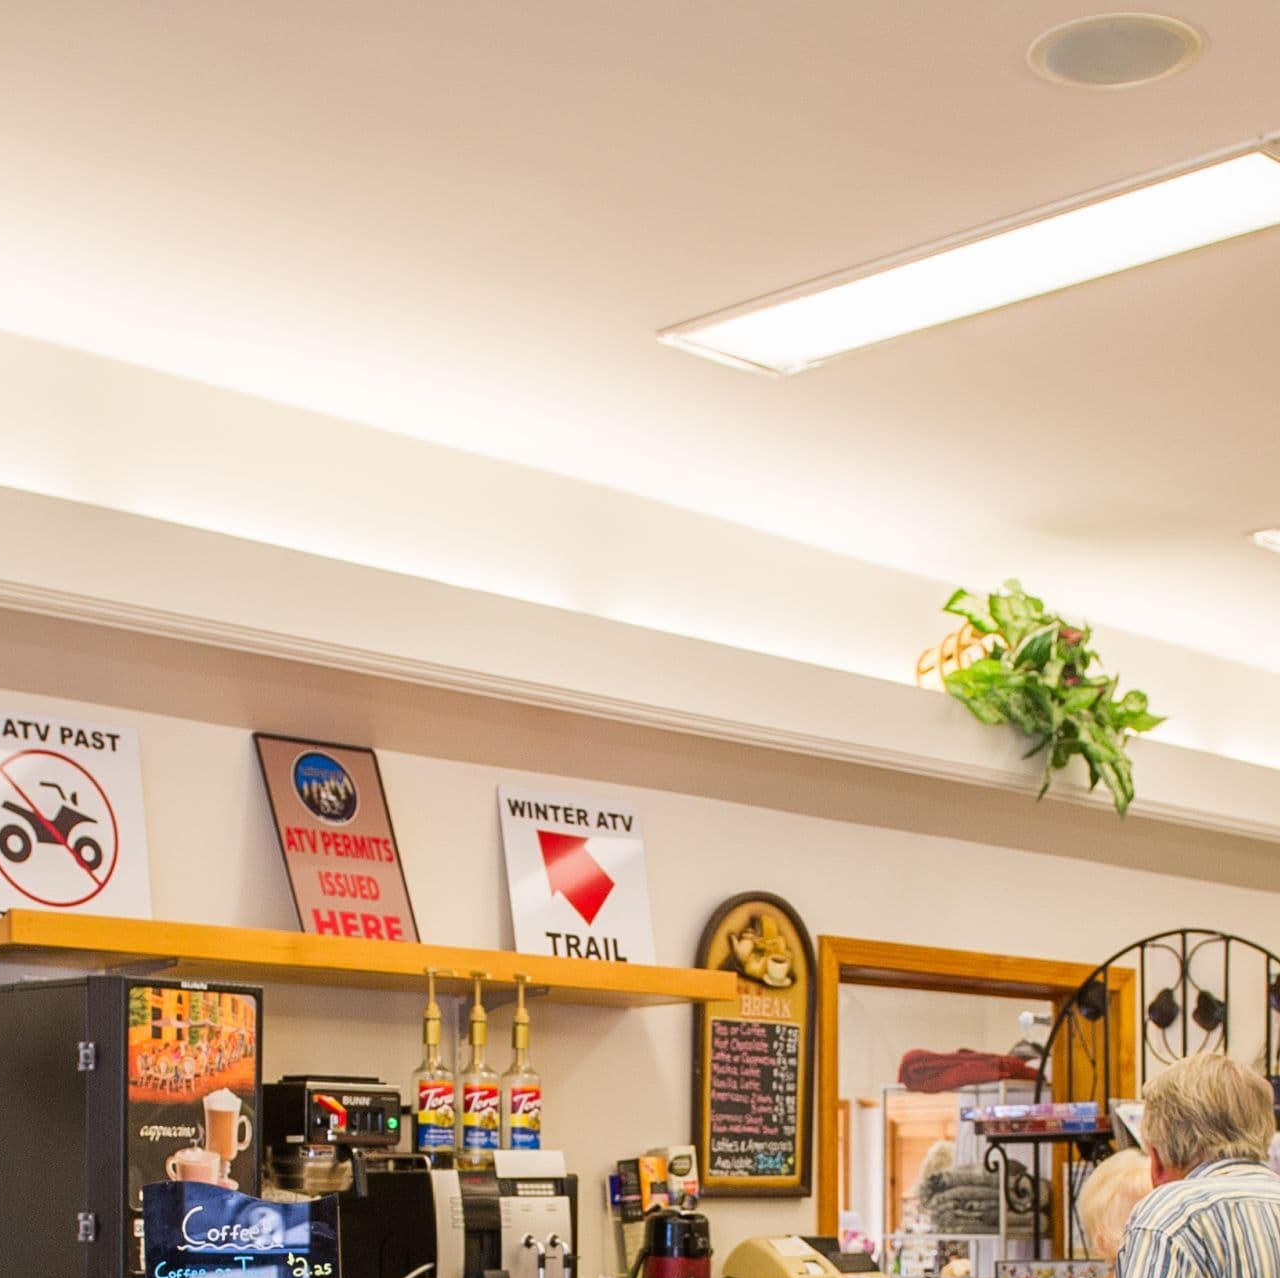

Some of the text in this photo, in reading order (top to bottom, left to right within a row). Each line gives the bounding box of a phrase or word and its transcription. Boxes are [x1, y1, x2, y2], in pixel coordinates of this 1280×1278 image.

[2, 718, 50, 742] ATV
[60, 726, 120, 752] PAST
[507, 798, 633, 832] WINTER ATV
[284, 826, 395, 863] ATV PERMITS
[319, 871, 380, 901] ISSUED
[312, 908, 407, 942] HERE
[545, 931, 628, 962] TRAIL
[741, 994, 792, 1018] BREAK
[342, 1095, 371, 1106] BUNN
[140, 1124, 195, 1142] cappuccino
[182, 1205, 261, 1245] Coffee
[286, 1252, 332, 1278] $2.25
